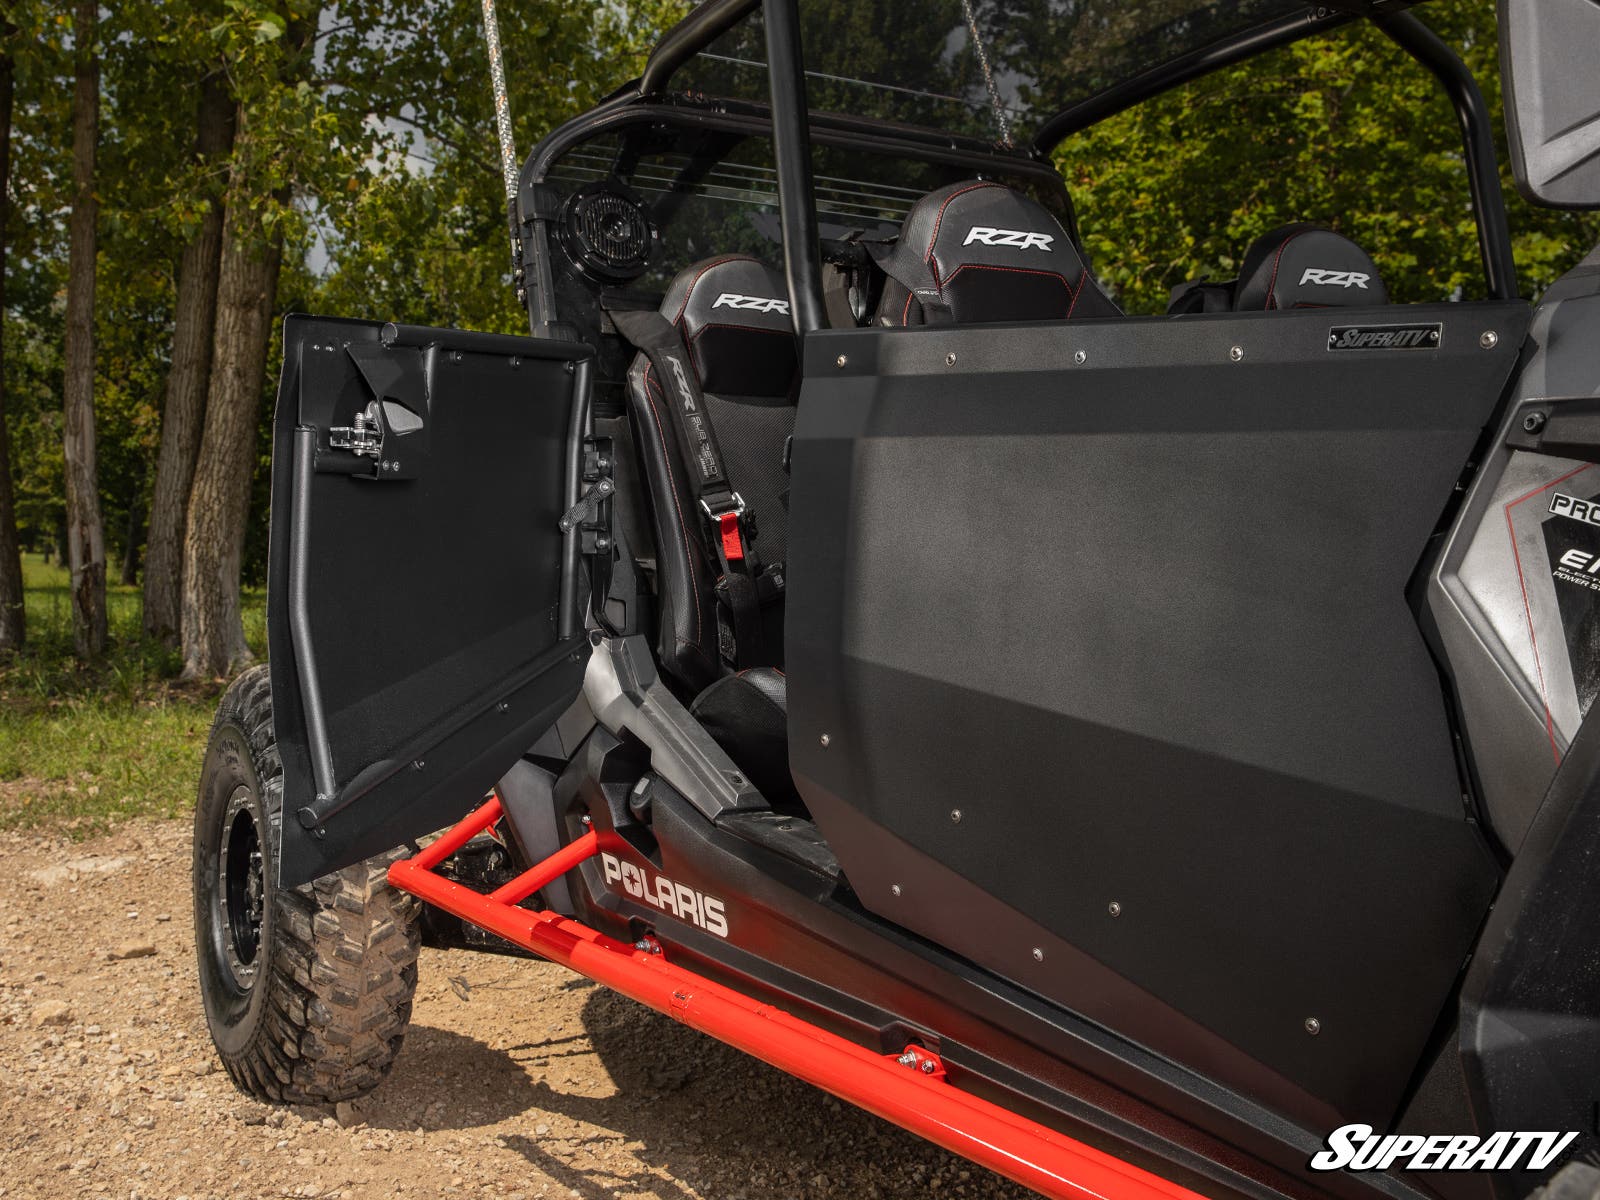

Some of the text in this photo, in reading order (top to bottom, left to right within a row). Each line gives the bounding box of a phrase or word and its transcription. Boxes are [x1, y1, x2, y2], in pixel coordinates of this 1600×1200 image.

[962, 226, 1054, 252] RZR
[1298, 268, 1371, 289] RZR
[711, 293, 790, 315] RZR
[666, 355, 696, 411] RZR
[1552, 570, 1590, 587] POWER
[601, 852, 729, 938] POLARIS
